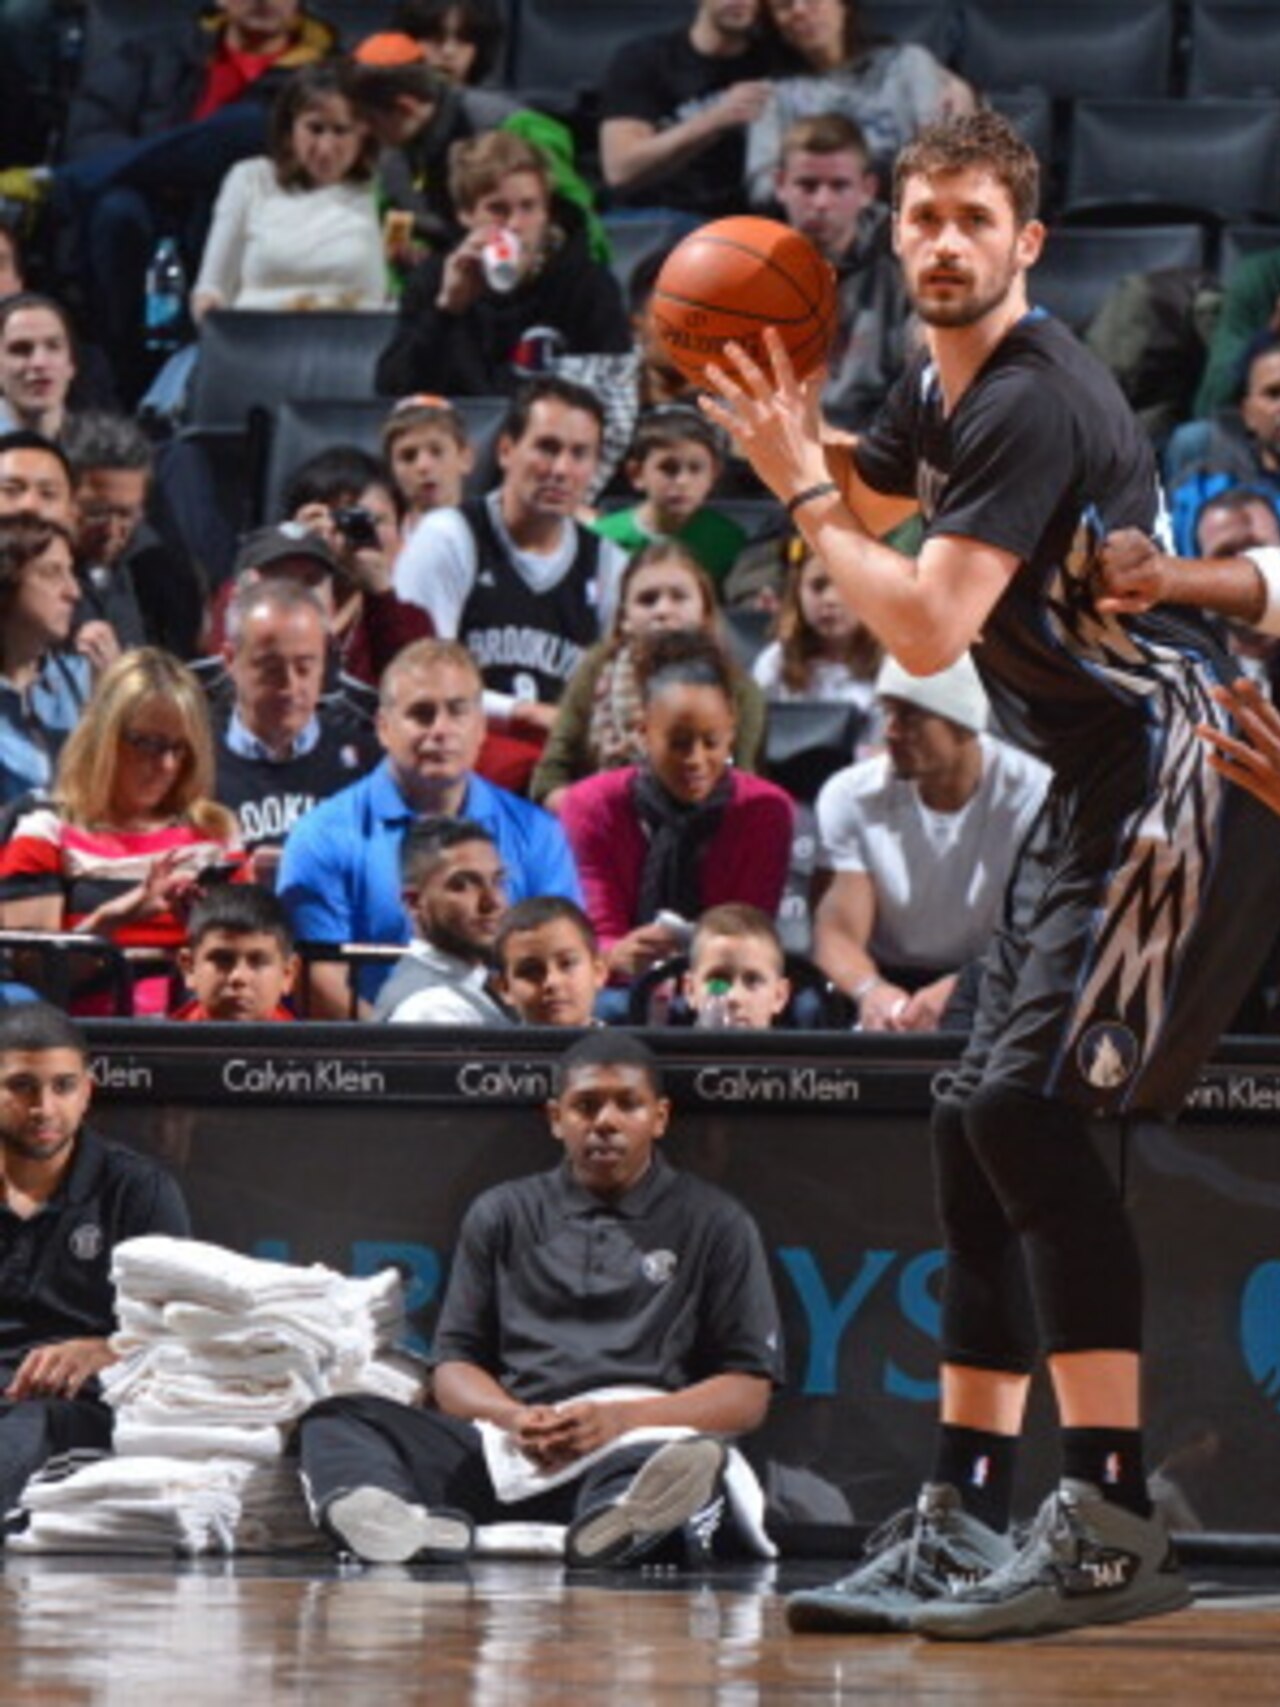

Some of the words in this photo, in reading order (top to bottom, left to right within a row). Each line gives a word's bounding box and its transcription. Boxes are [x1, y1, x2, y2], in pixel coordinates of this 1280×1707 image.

[222, 1059, 311, 1092] Calvin
[315, 1059, 385, 1092] Klein
[456, 1061, 548, 1097] Calvin
[694, 1067, 786, 1101] Calvin
[789, 1067, 860, 1101] Klein
